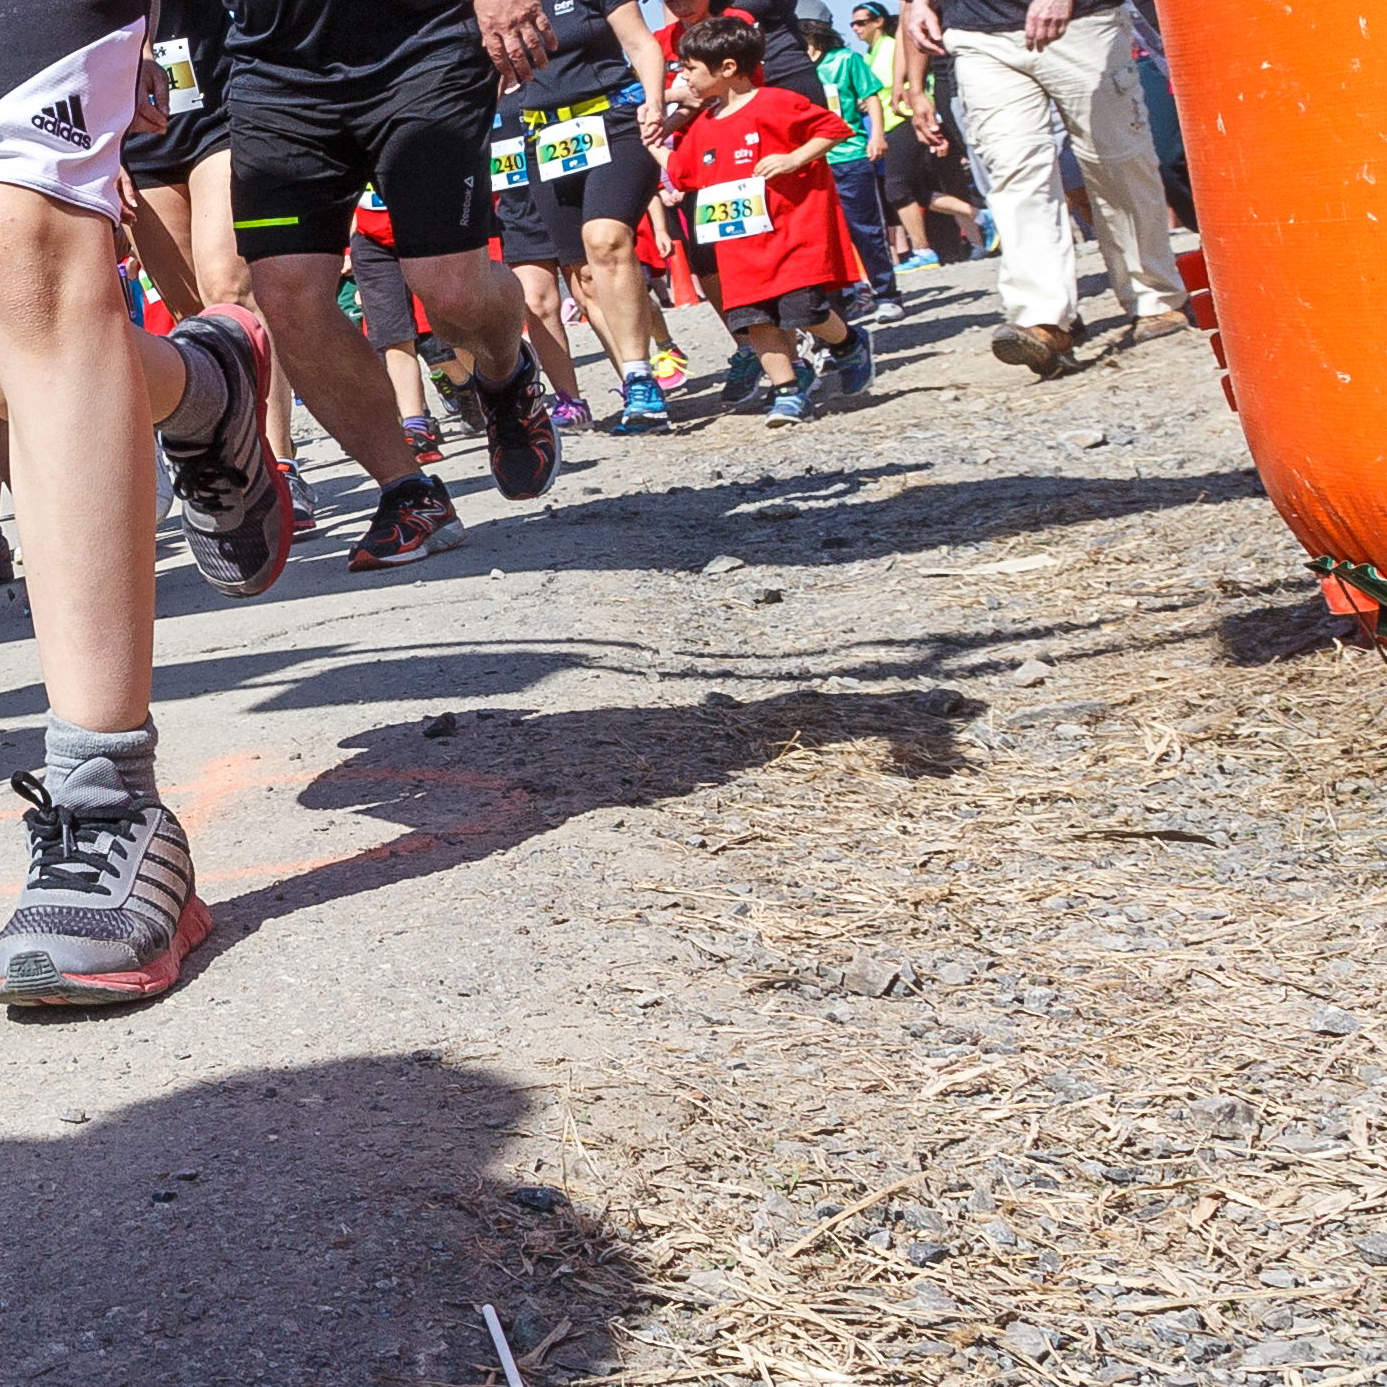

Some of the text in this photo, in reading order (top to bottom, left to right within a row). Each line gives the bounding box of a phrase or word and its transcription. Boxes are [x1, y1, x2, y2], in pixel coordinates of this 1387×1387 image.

[31, 114, 92, 150] adidas
[546, 133, 593, 162] 2329
[459, 188, 473, 226] Reebok
[705, 199, 753, 223] 2338
